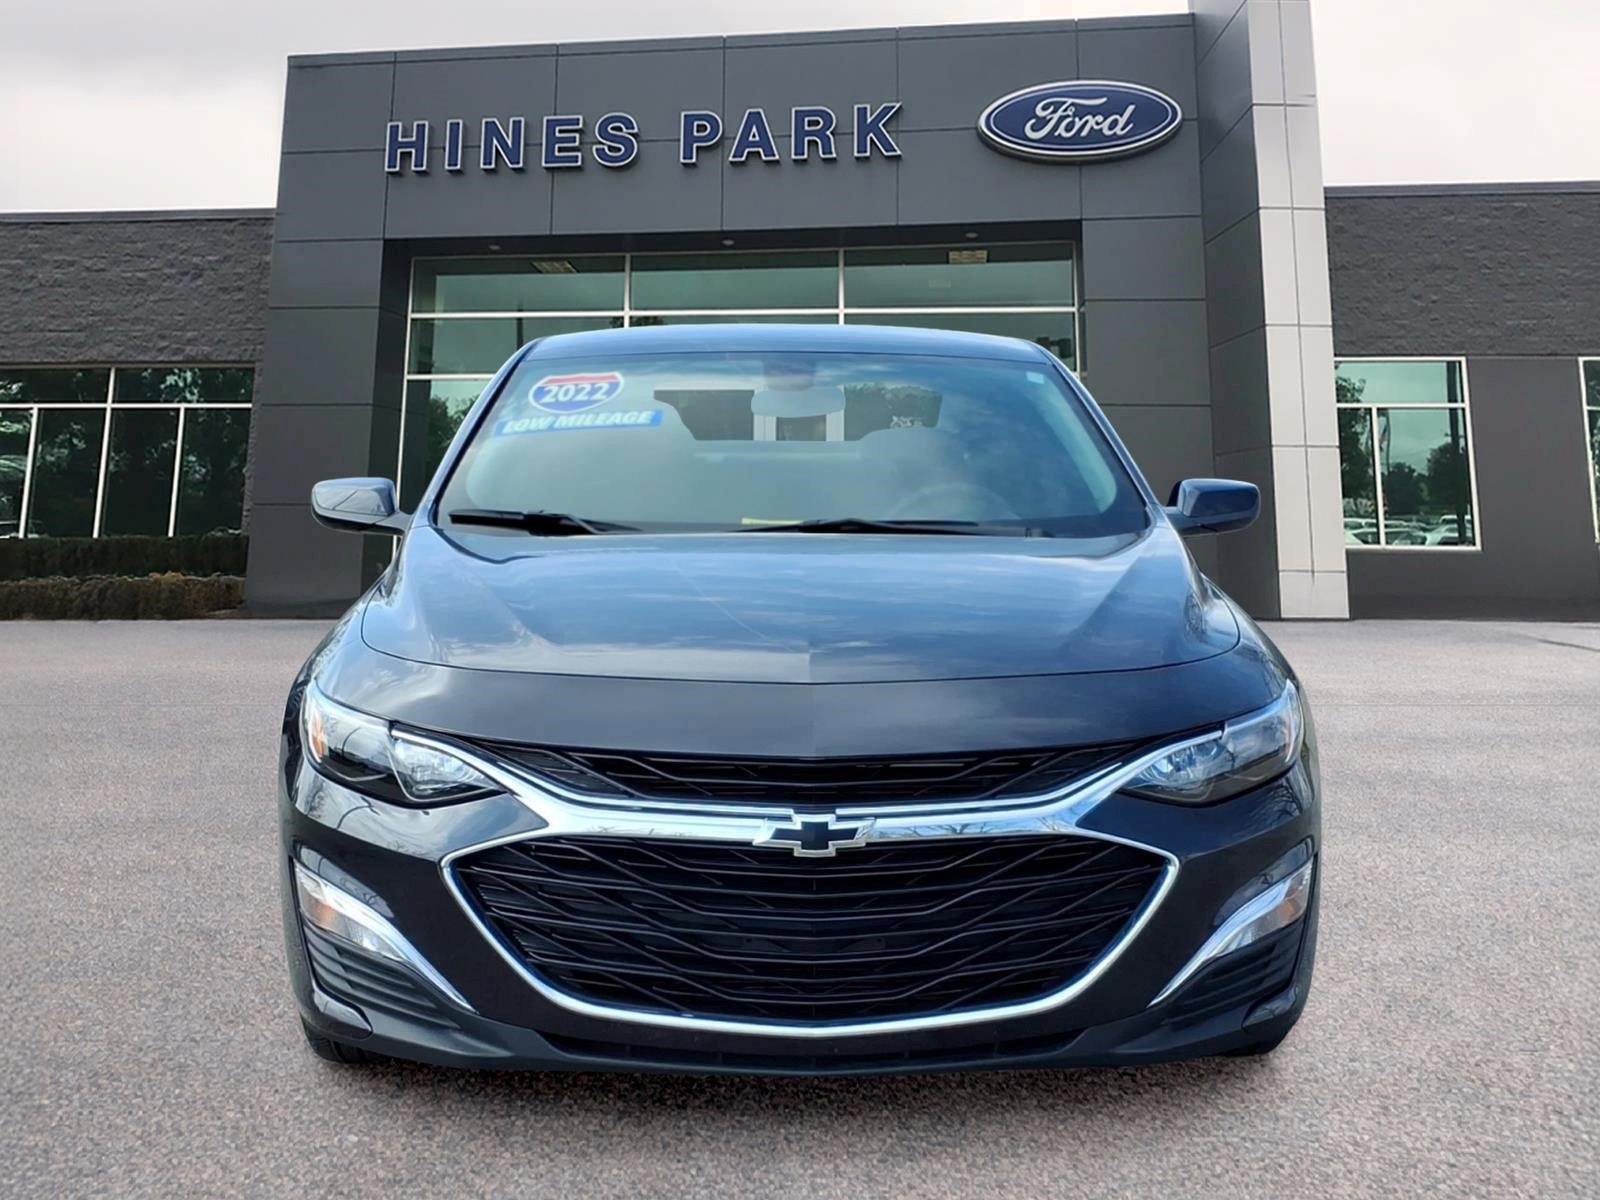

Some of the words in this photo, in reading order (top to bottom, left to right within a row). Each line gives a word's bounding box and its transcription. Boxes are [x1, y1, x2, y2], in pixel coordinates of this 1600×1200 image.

[1024, 97, 1136, 139] Ford
[384, 112, 639, 172] HINES
[680, 102, 902, 164] PARK
[541, 383, 609, 402] 2022
[502, 416, 552, 434] LOW
[554, 411, 654, 428] MILEAGE
